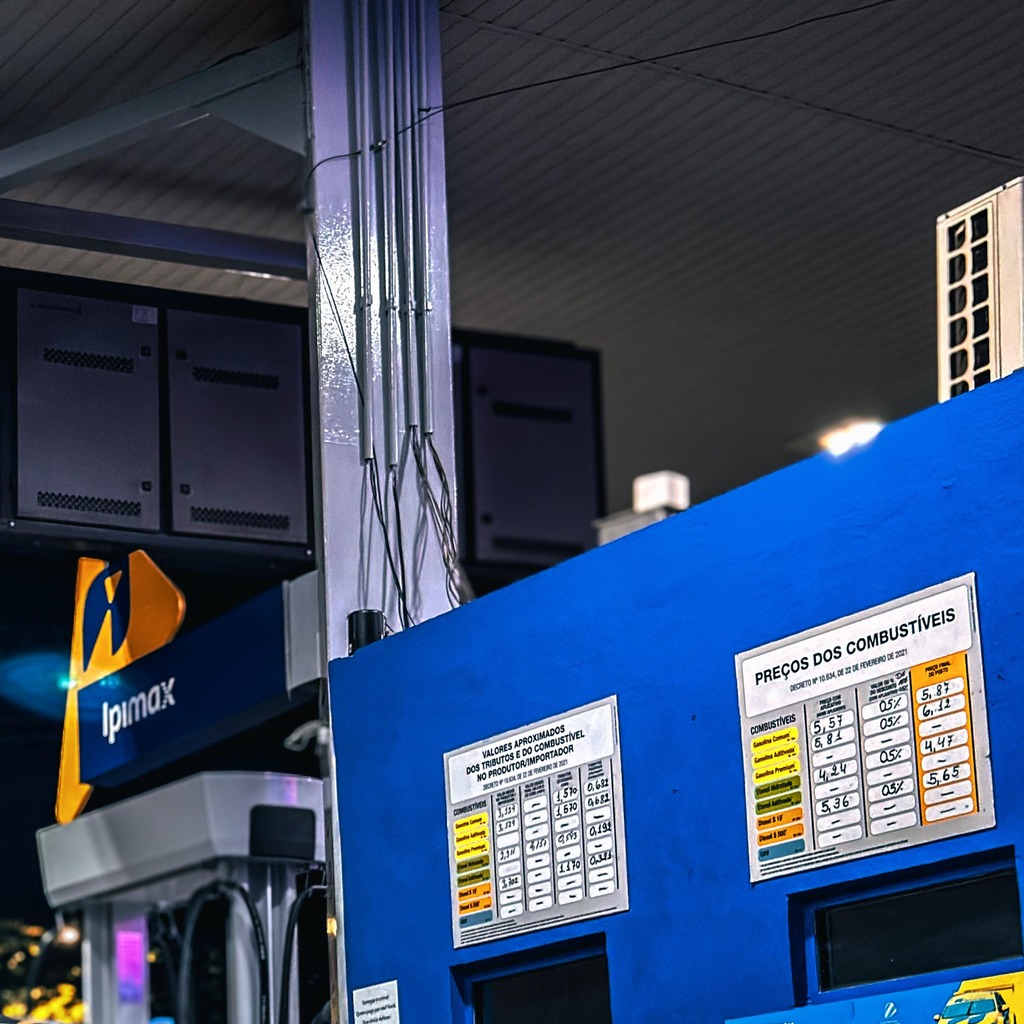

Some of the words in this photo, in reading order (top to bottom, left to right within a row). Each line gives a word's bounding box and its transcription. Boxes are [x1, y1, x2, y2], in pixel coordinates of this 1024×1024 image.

[755, 657, 809, 686] PREÇOS
[813, 646, 842, 667] DOS
[846, 608, 956, 655] COMBUSTÍVEIS
[790, 679, 812, 692] DECRETO
[837, 669, 844, 677] DE
[852, 664, 860, 672] DE
[860, 655, 887, 669] FEVEREIRO
[887, 652, 894, 661] DE
[895, 648, 908, 658] 2021
[102, 677, 176, 744] Ipimax
[750, 713, 797, 736] COMBUSTÍVEIS
[813, 714, 843, 735] 5,57
[466, 763, 480, 775] DOS
[481, 752, 515, 770] TRIBUTOS
[516, 750, 521, 758] E
[522, 746, 533, 757] DO
[534, 729, 586, 753] COMBUSTÍVEL
[482, 742, 513, 759] VALORES
[514, 724, 566, 749] APROXIMADOS
[924, 734, 954, 753] 4,47
[477, 772, 487, 782] NO
[488, 744, 574, 779] PRODUTOR/IMPORTADOR
[819, 762, 847, 782] 4,24
[821, 794, 850, 814] 5,36
